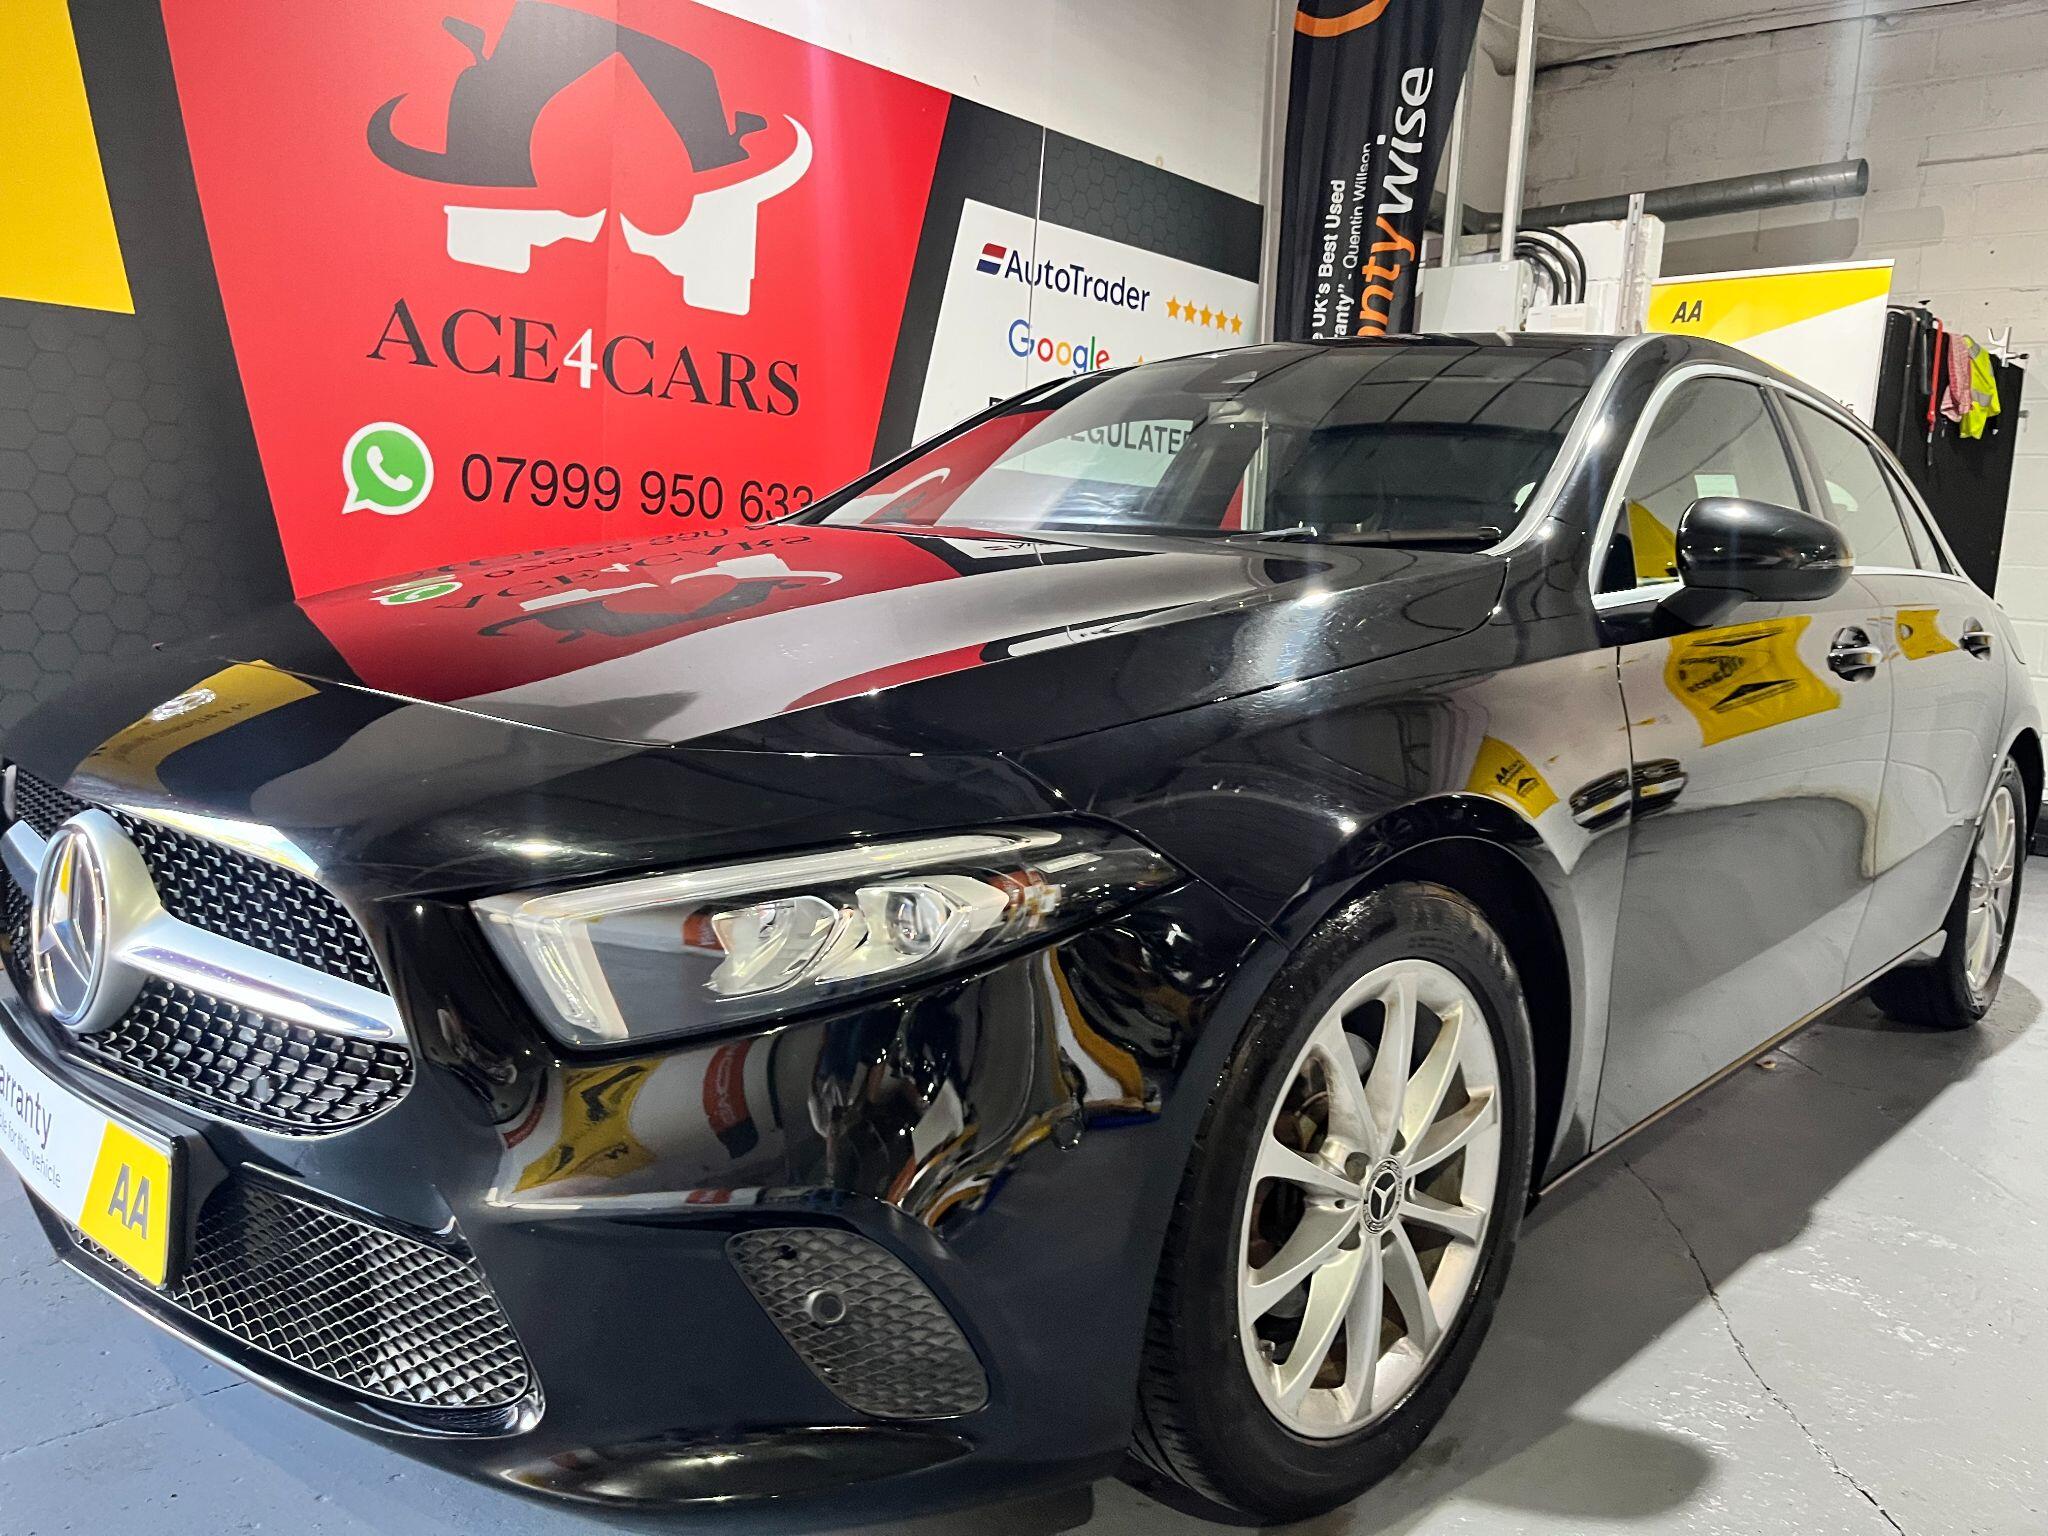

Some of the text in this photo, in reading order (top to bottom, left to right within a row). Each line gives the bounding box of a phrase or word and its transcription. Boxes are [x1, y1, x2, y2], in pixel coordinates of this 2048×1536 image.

[1352, 142, 1371, 201] Willson
[1324, 179, 1346, 229] Used
[1318, 234, 1339, 277] Best
[1342, 205, 1363, 269] Quentin
[1004, 249, 1150, 312] AutoTrader
[1312, 283, 1331, 327] UK's
[1671, 299, 1702, 324] AA
[366, 297, 800, 416] ACE4CARS
[1008, 319, 1110, 372] Google
[461, 453, 622, 511] 07999
[639, 470, 724, 520] 950
[107, 1162, 151, 1241] AA
